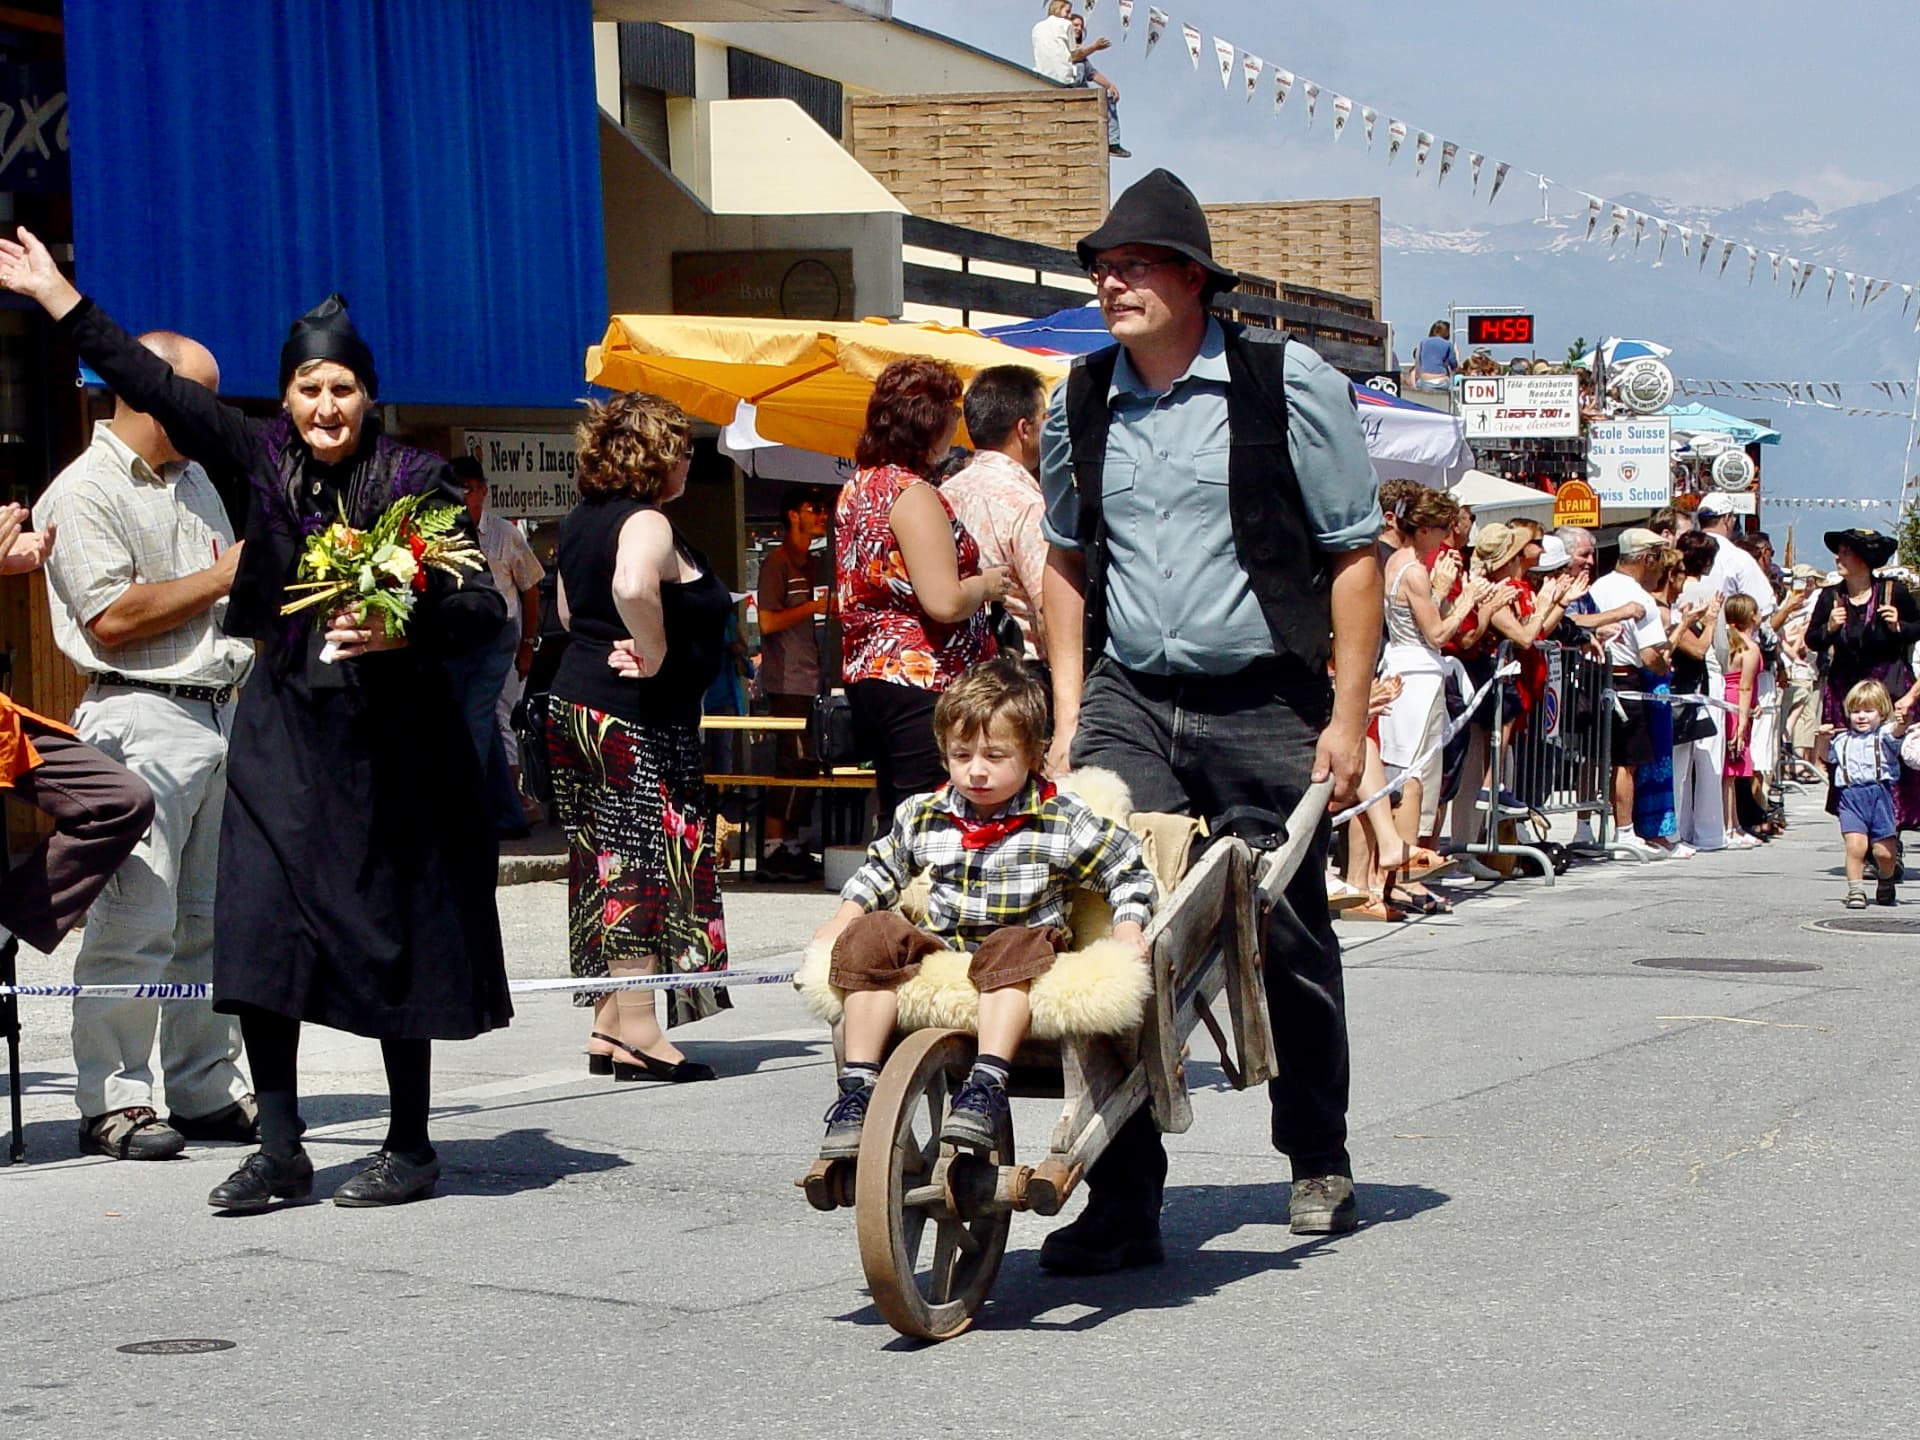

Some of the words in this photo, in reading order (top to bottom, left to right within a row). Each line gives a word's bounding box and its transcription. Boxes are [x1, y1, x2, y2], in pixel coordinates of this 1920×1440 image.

[1468, 385, 1495, 398] TDN
[1529, 390, 1558, 398] Nendaz
[1539, 408, 1563, 418] 2001
[1627, 425, 1665, 439] Suisse
[1592, 445, 1606, 455] Ski
[1619, 444, 1665, 454] Snowboard
[489, 441, 533, 472] New's
[1594, 487, 1624, 501] wiss
[1629, 487, 1667, 501] School
